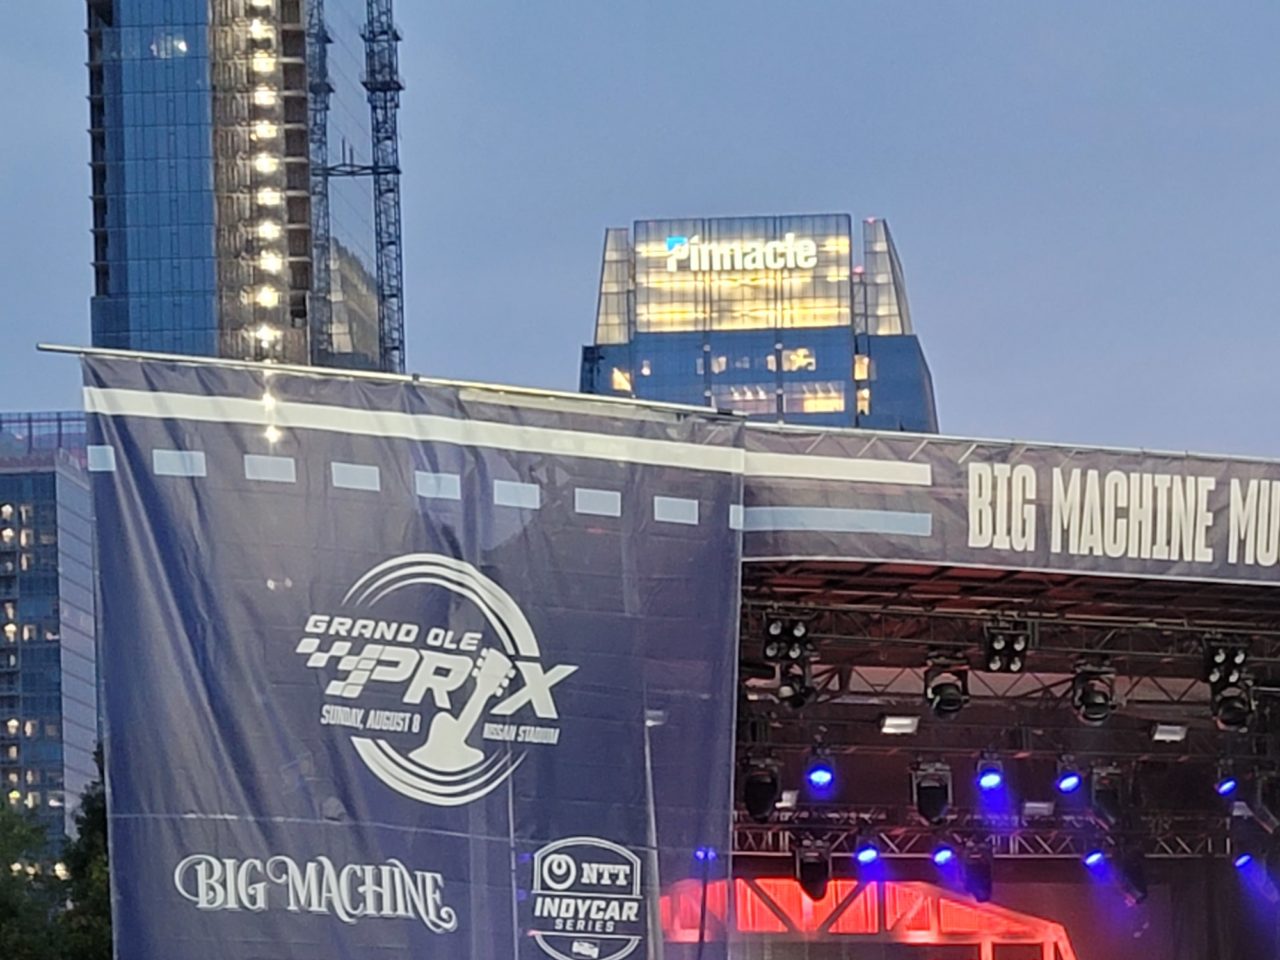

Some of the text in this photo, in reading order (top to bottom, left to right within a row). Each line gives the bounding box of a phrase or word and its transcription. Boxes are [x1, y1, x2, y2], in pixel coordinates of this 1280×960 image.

[665, 232, 818, 272] Pinnacle
[968, 462, 1037, 552] BIG
[1050, 467, 1215, 563] MACHINE
[304, 614, 483, 652] GRAND OLE
[320, 704, 421, 733] SUNDAY, AUGUST 8
[516, 726, 560, 744] STADIUM
[580, 863, 631, 887] NTT
[174, 854, 458, 934] BIG MACHINE
[533, 897, 641, 922] INDYCAR
[554, 918, 616, 933] SERIES
